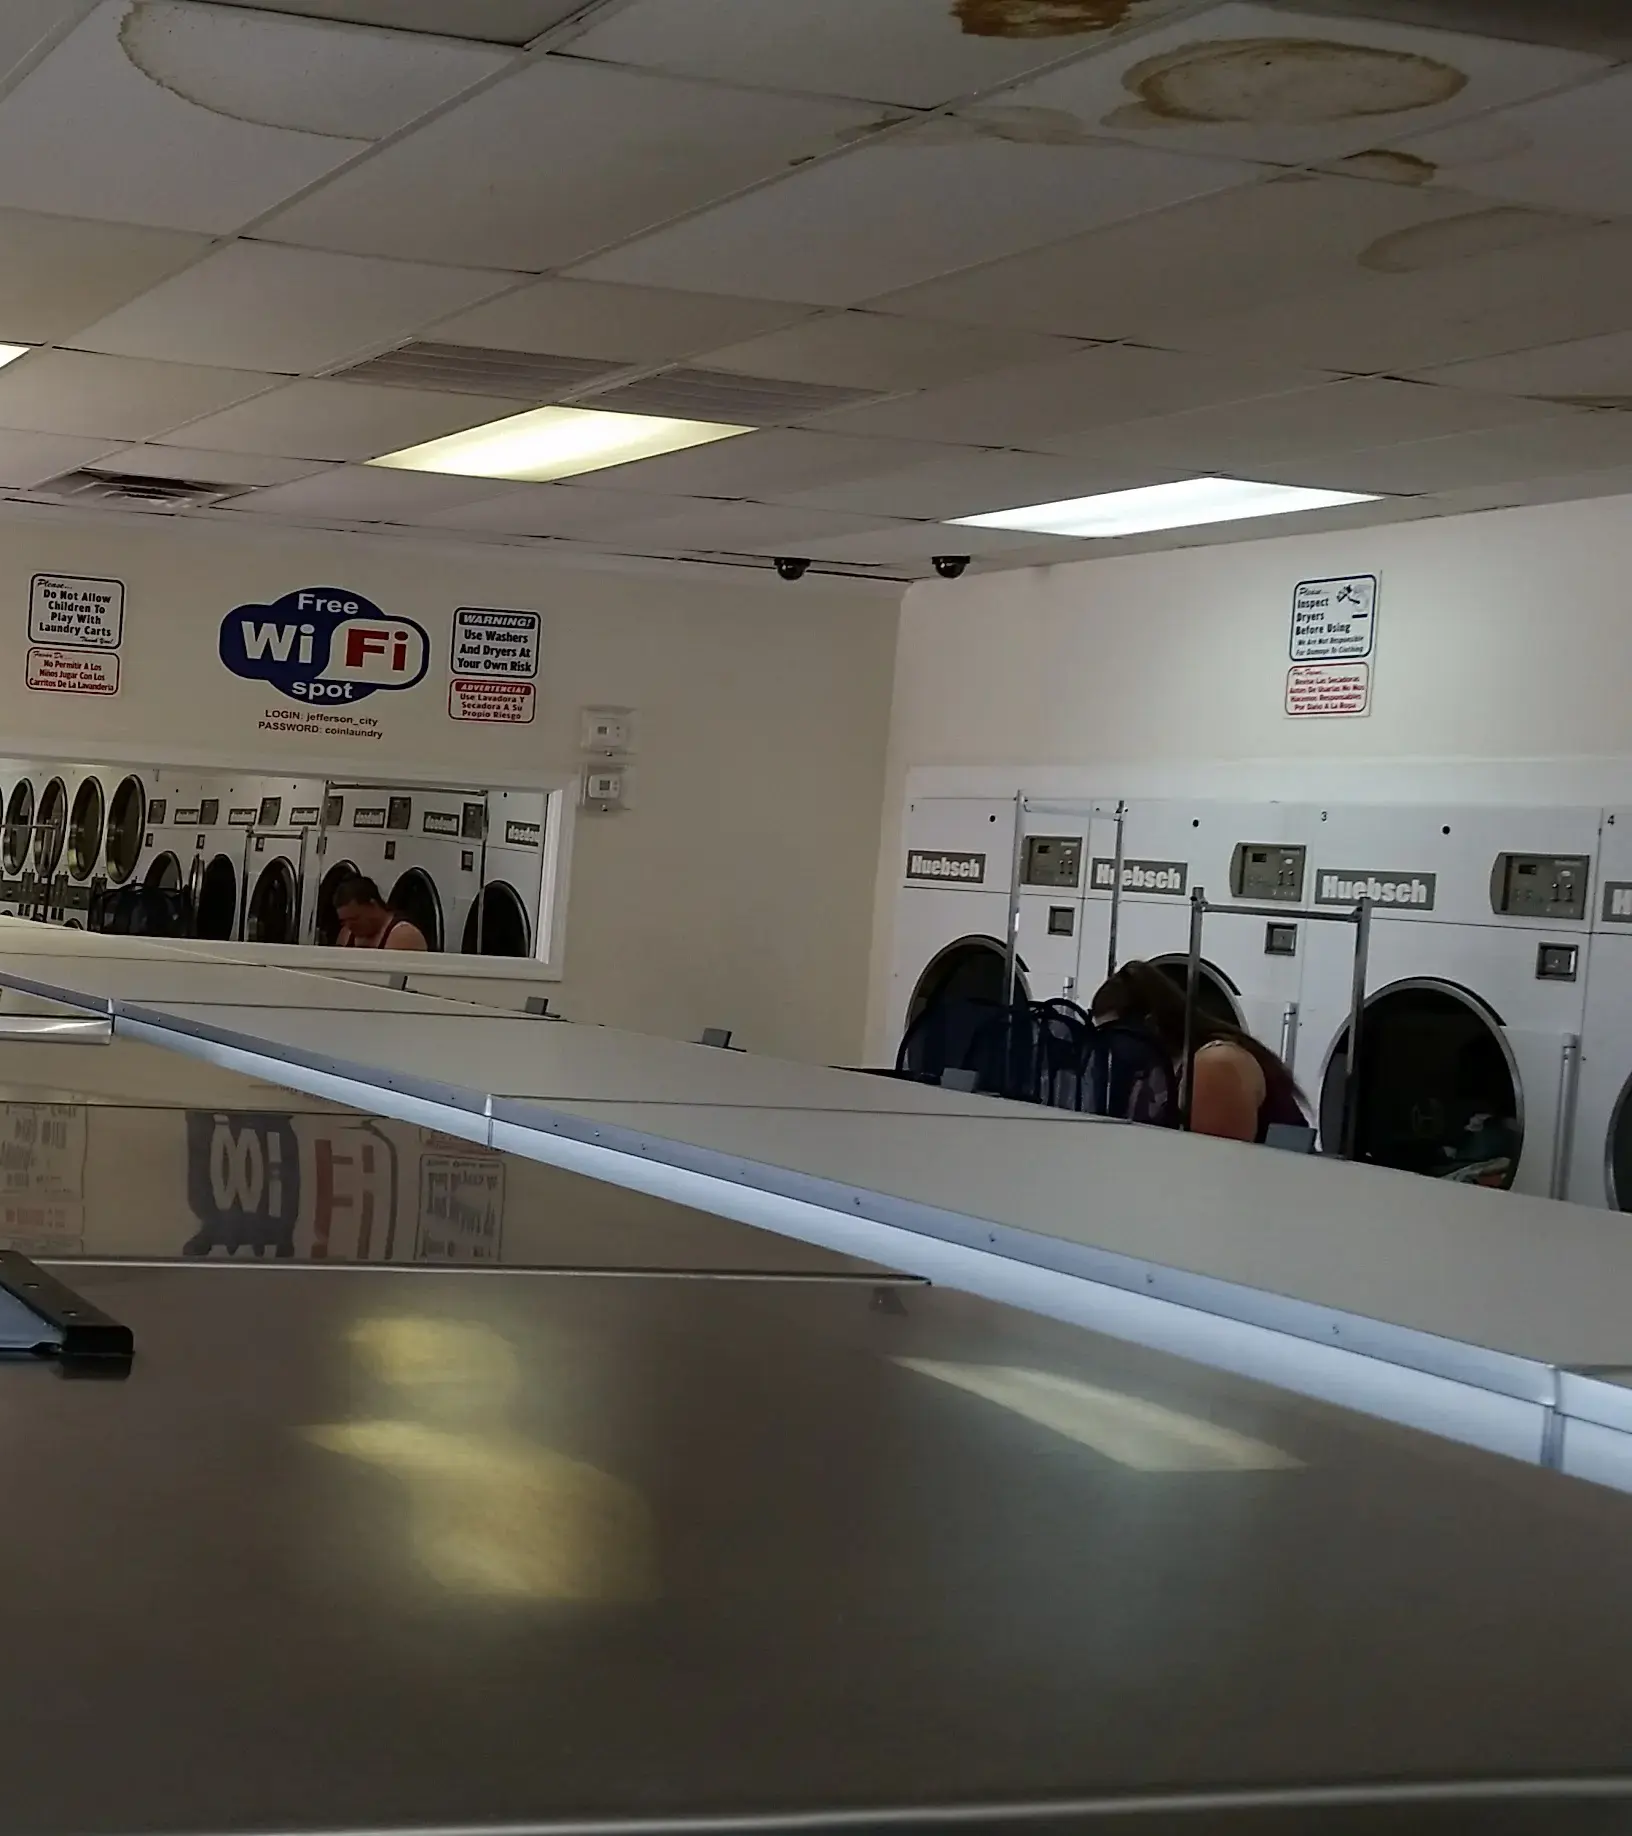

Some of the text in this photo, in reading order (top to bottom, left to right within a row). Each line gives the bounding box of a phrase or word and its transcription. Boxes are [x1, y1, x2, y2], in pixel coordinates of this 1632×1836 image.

[44, 589, 112, 604] Do Not Allow
[48, 600, 106, 614] Children To
[297, 593, 359, 615] Free
[1298, 598, 1329, 609] Inspect
[50, 612, 102, 624] Play With
[463, 614, 532, 627] WARNING!
[1296, 612, 1324, 624] Dryers
[39, 622, 112, 636] Laundry Carts
[1296, 623, 1351, 635] Before Using
[464, 629, 529, 644] Use Washers
[460, 644, 532, 658] And Dryers At
[44, 660, 54, 668] No
[84, 662, 88, 670] A
[457, 658, 532, 672] Your Own Risk
[80, 672, 92, 680] Con
[94, 673, 105, 681] Los
[58, 680, 67, 688] De
[291, 681, 354, 700] spot
[478, 694, 517, 702] Lavadora
[461, 702, 501, 710] Secadora
[512, 704, 522, 712] Su
[265, 710, 378, 727] LOGIN: jefferson_city
[462, 710, 522, 720] Propio Riesgo
[258, 721, 383, 740] PASSWORD: coinlaundry
[1320, 811, 1328, 822] 3
[1607, 814, 1616, 826] 4
[910, 855, 980, 878] Huebsch
[1322, 875, 1428, 904] Huebsch
